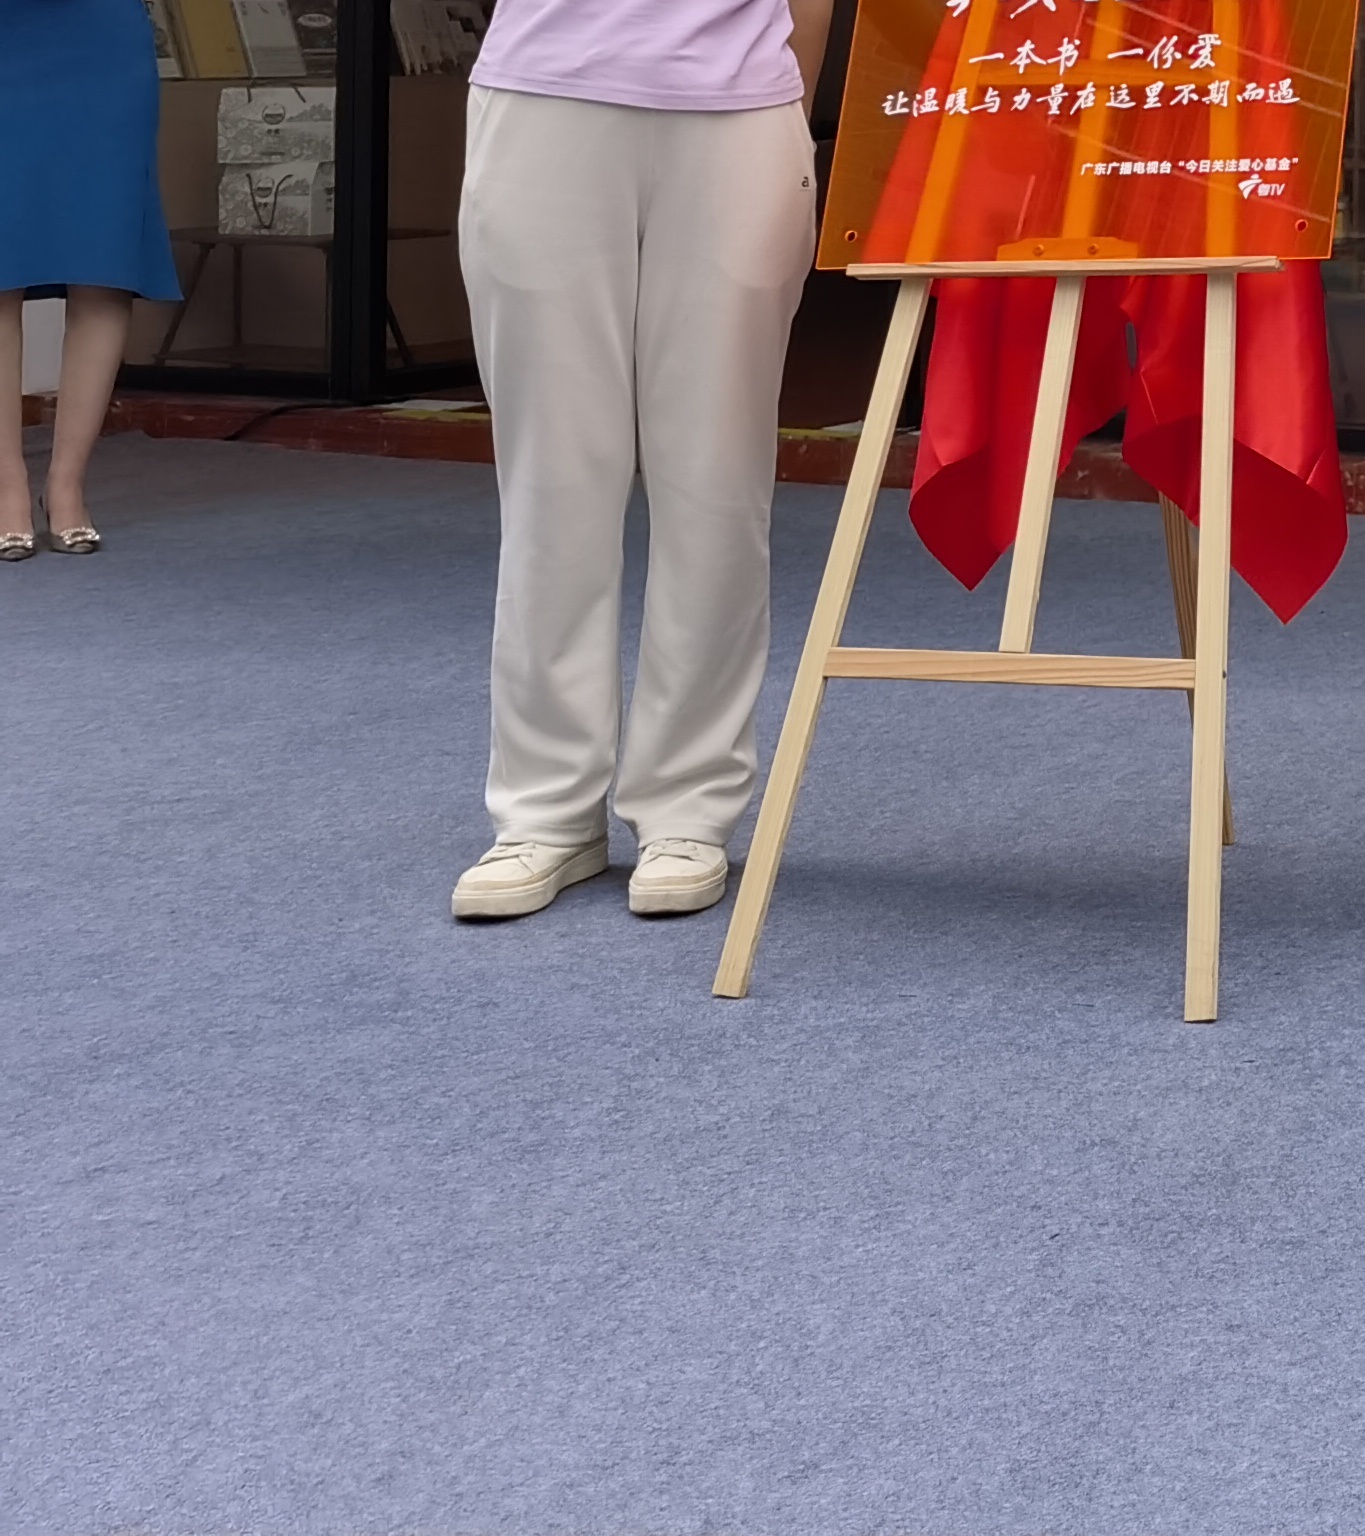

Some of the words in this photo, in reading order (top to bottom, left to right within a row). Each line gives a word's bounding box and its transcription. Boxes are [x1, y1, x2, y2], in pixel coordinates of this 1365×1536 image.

[969, 37, 1080, 75] 一本书
[1107, 33, 1221, 70] 一份爱
[881, 77, 1301, 118] 让温暖与力量在这里不期而遇
